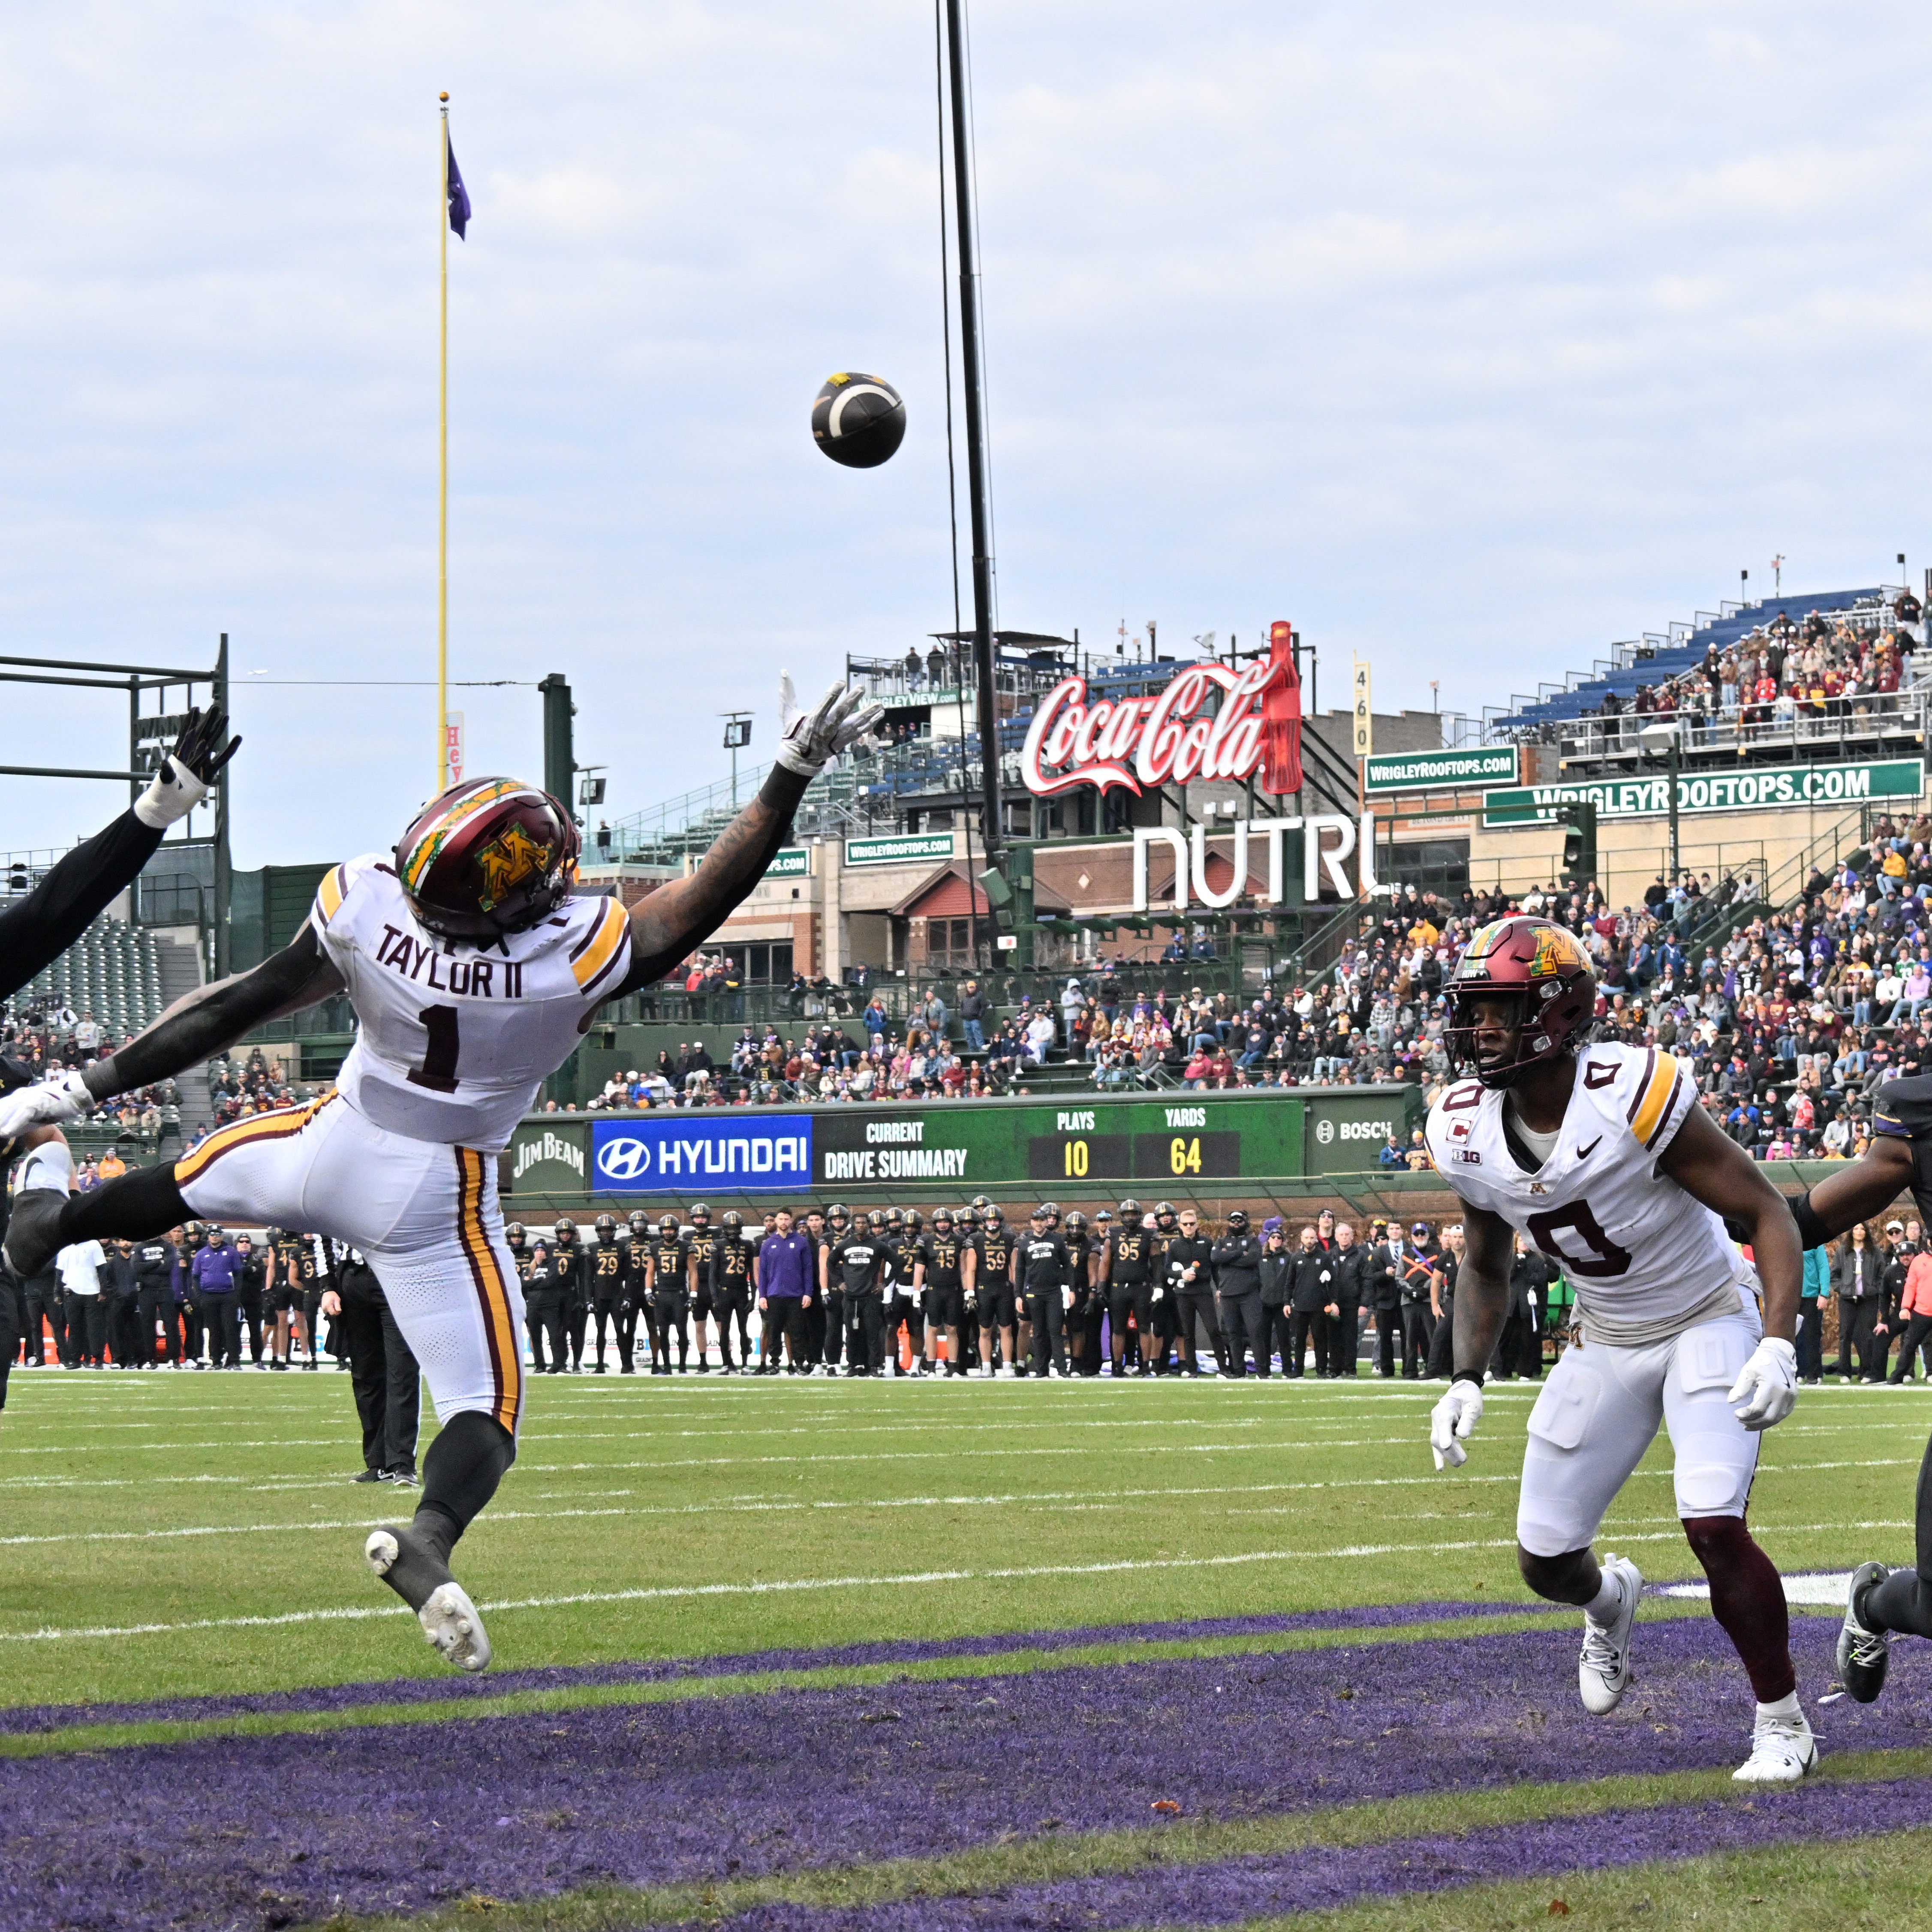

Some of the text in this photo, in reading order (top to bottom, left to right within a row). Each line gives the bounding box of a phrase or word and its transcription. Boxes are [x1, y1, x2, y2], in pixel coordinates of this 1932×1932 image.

[1022, 659, 1281, 797] Coca-Cola
[446, 726, 463, 784] Hey
[376, 923, 522, 998] TAYLOR II
[1462, 969, 1478, 978] ROW
[406, 1004, 460, 1093] 1
[1583, 1061, 1622, 1089] 0
[1442, 1085, 1485, 1112] 0
[1057, 1111, 1095, 1130] PLAYS
[1165, 1107, 1206, 1127] YARDS
[867, 1122, 924, 1143] CURRENT
[1340, 1122, 1392, 1139] BOSCH
[513, 1132, 584, 1178] JIM BEAM
[659, 1137, 807, 1174] HYUNDAI
[825, 1149, 967, 1179] DRIVE SUMMARY
[1065, 1141, 1088, 1176] 10
[1171, 1138, 1201, 1174] 64
[1526, 1199, 1632, 1277] 0
[279, 1249, 287, 1266] 4
[936, 1250, 955, 1269] 45
[986, 1251, 1006, 1270] 59
[1119, 1242, 1139, 1261] 95
[304, 1261, 314, 1278] 9
[558, 1257, 568, 1275] 0
[597, 1256, 618, 1275] 29
[661, 1256, 676, 1273] 51
[725, 1255, 745, 1274] 28
[904, 1255, 913, 1273] 2
